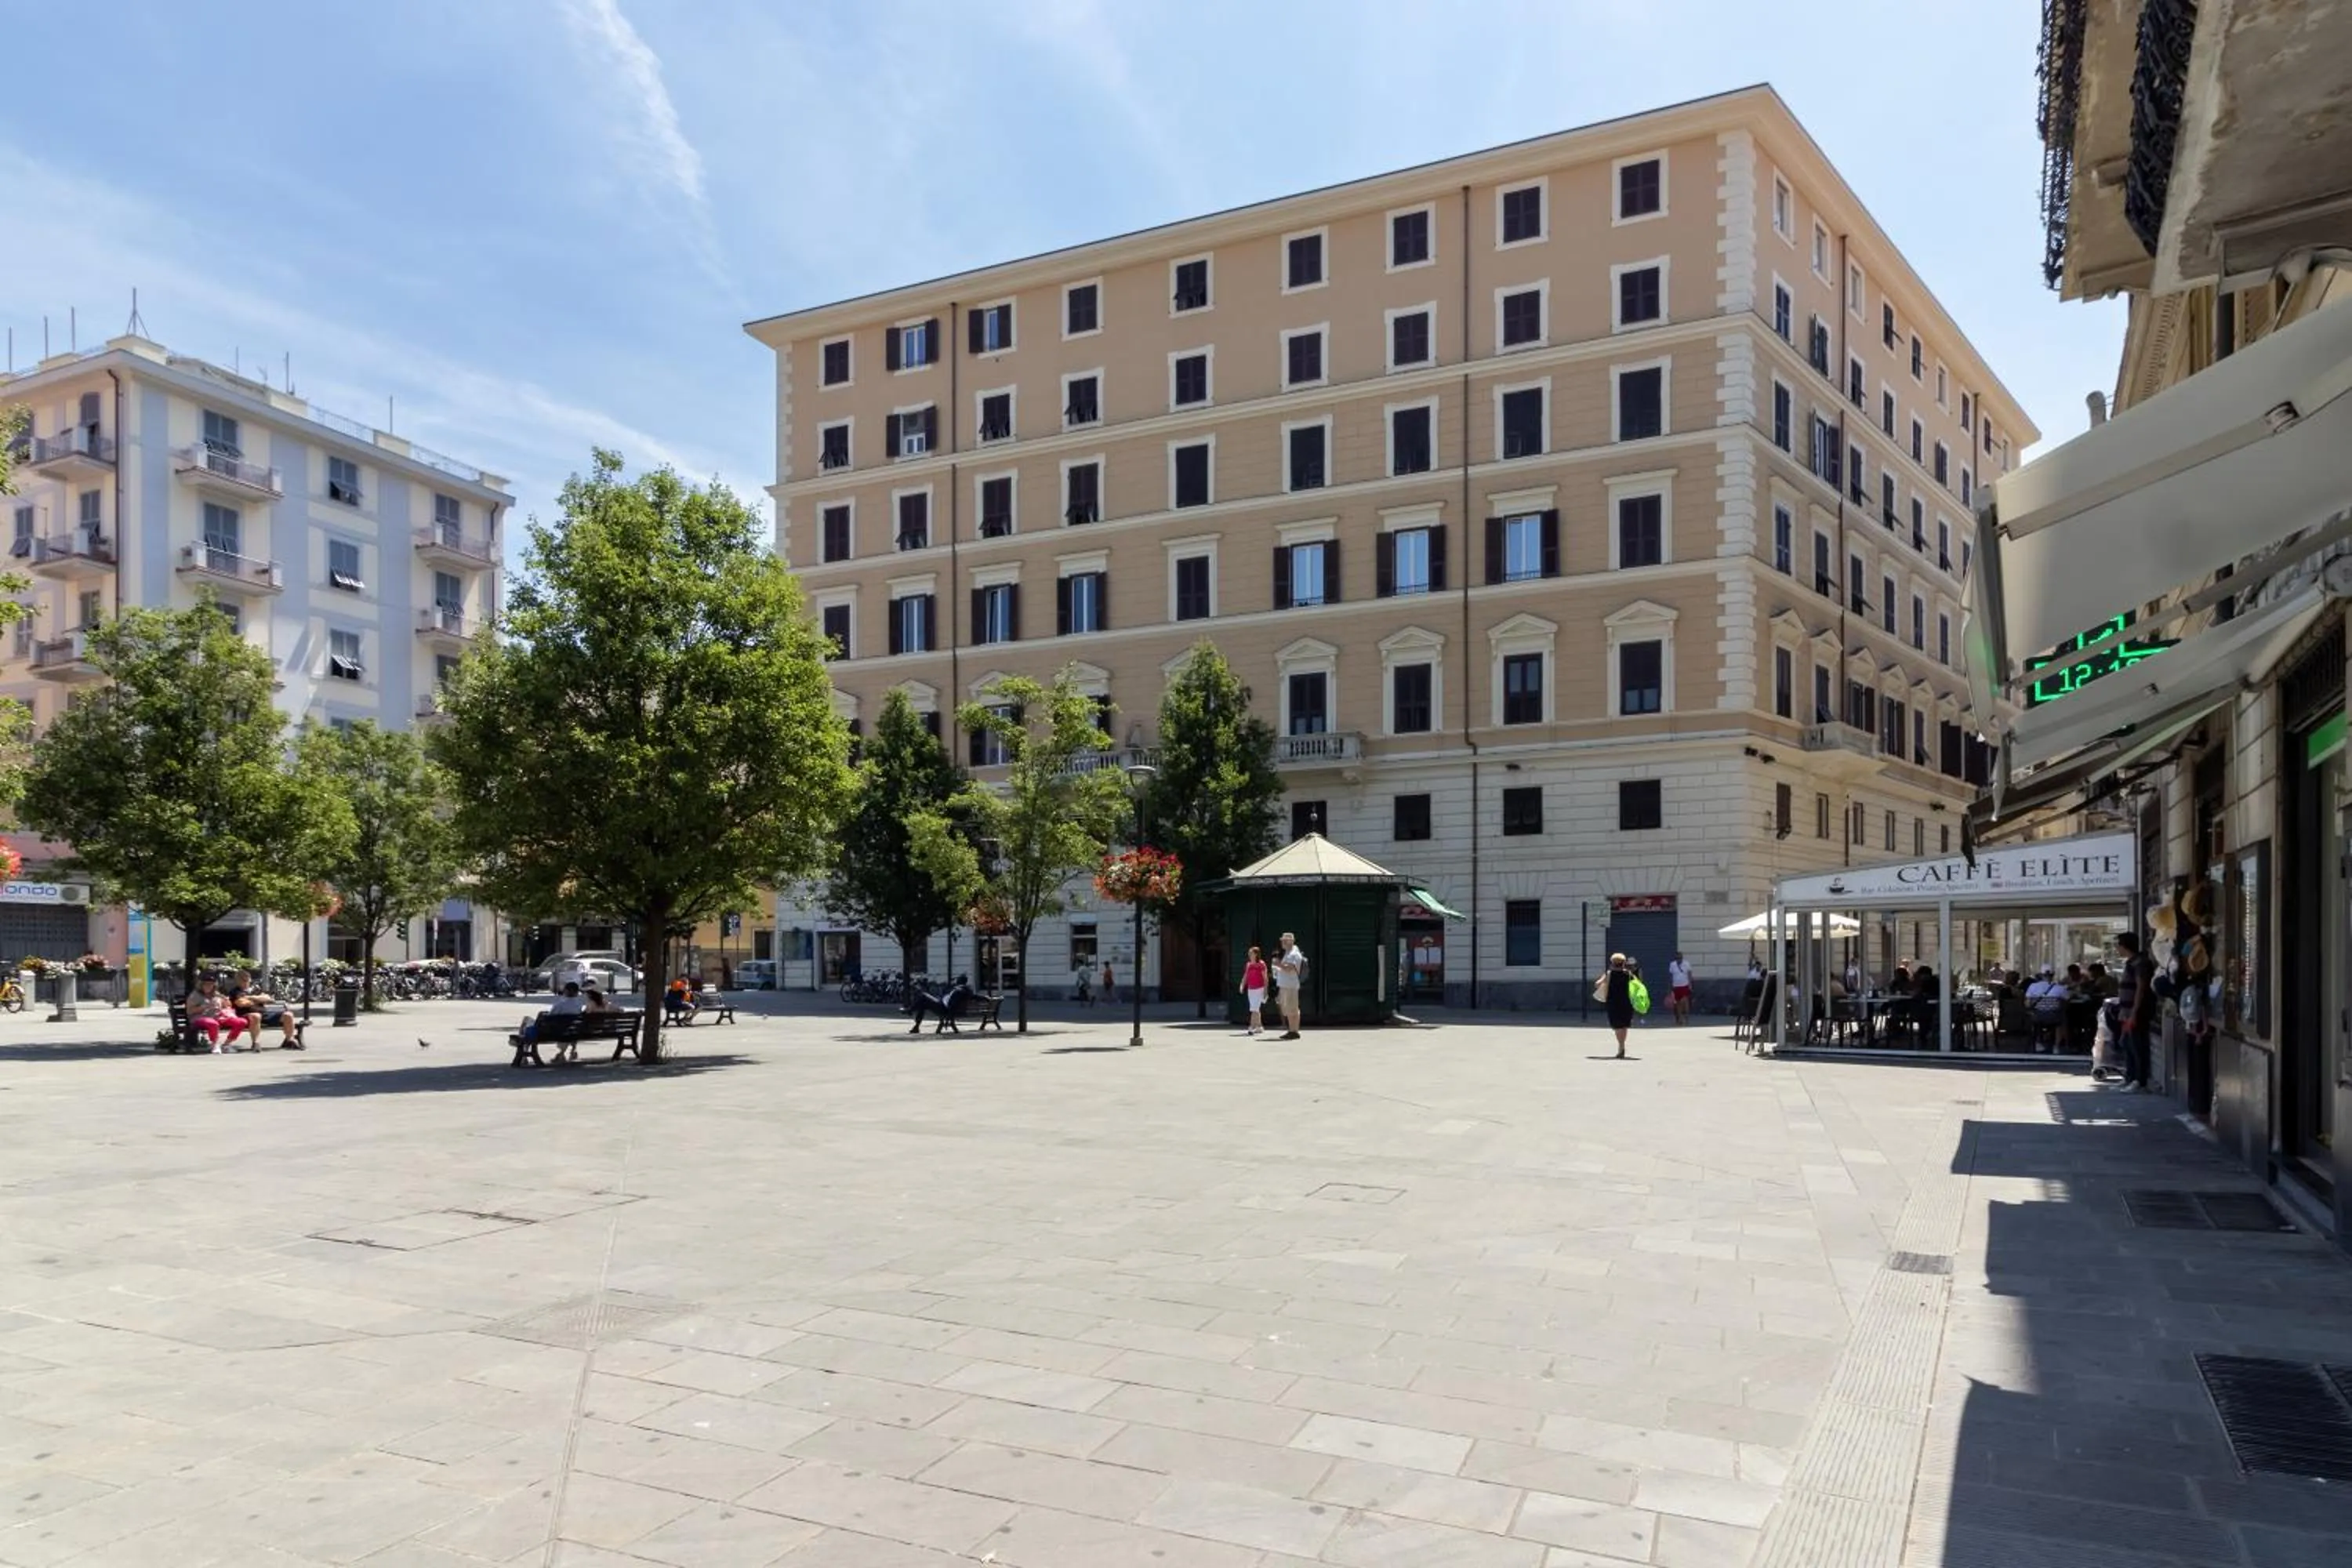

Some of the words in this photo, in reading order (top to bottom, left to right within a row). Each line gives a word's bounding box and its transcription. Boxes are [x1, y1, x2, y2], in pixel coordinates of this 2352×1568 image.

[1897, 858, 2001, 883] CAFFÈ
[2020, 854, 2119, 877] ELÌTE
[0, 885, 57, 895] ondo
